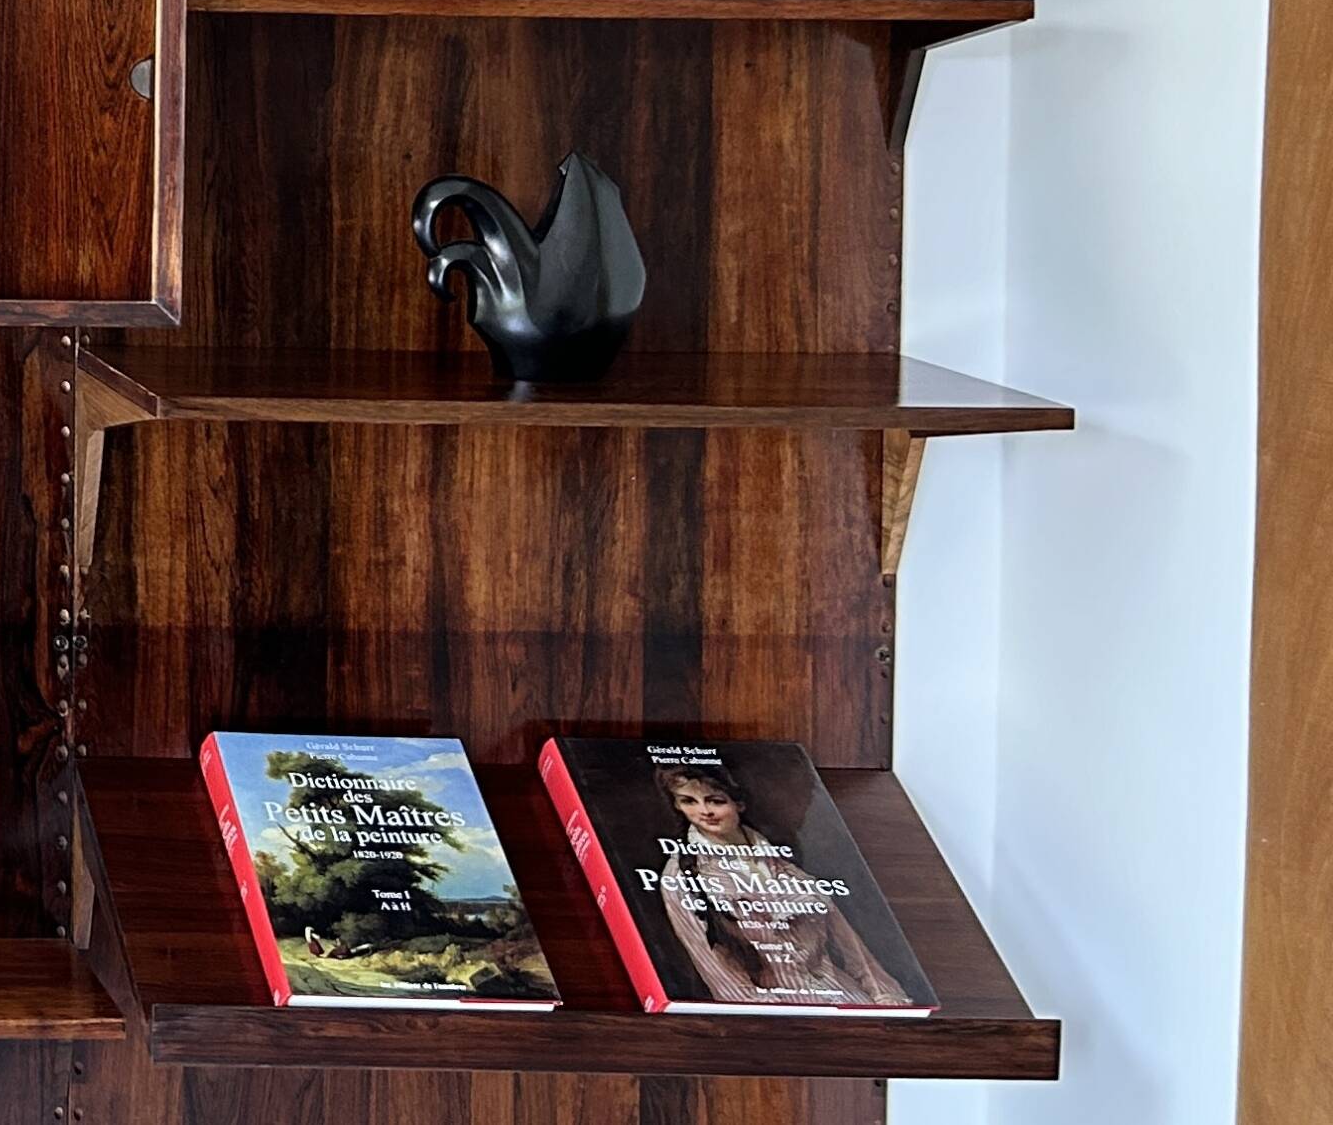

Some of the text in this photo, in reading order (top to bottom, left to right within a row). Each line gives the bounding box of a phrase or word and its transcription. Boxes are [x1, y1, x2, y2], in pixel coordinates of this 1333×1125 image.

[288, 772, 417, 791] Dictionnaire
[342, 789, 374, 803] des
[263, 800, 466, 827] Petits Maîtres
[299, 826, 443, 847] de la peinture
[352, 849, 404, 860] 1820-1920
[657, 838, 794, 858] Dictionnaire
[718, 855, 750, 871] des
[635, 868, 851, 897] Petits Maîtres
[371, 889, 403, 899] Tome
[381, 901, 391, 911] A
[401, 901, 412, 911] H
[680, 892, 828, 915] de la peinture
[737, 920, 790, 930] 1820-1920
[749, 940, 783, 950] Tome
